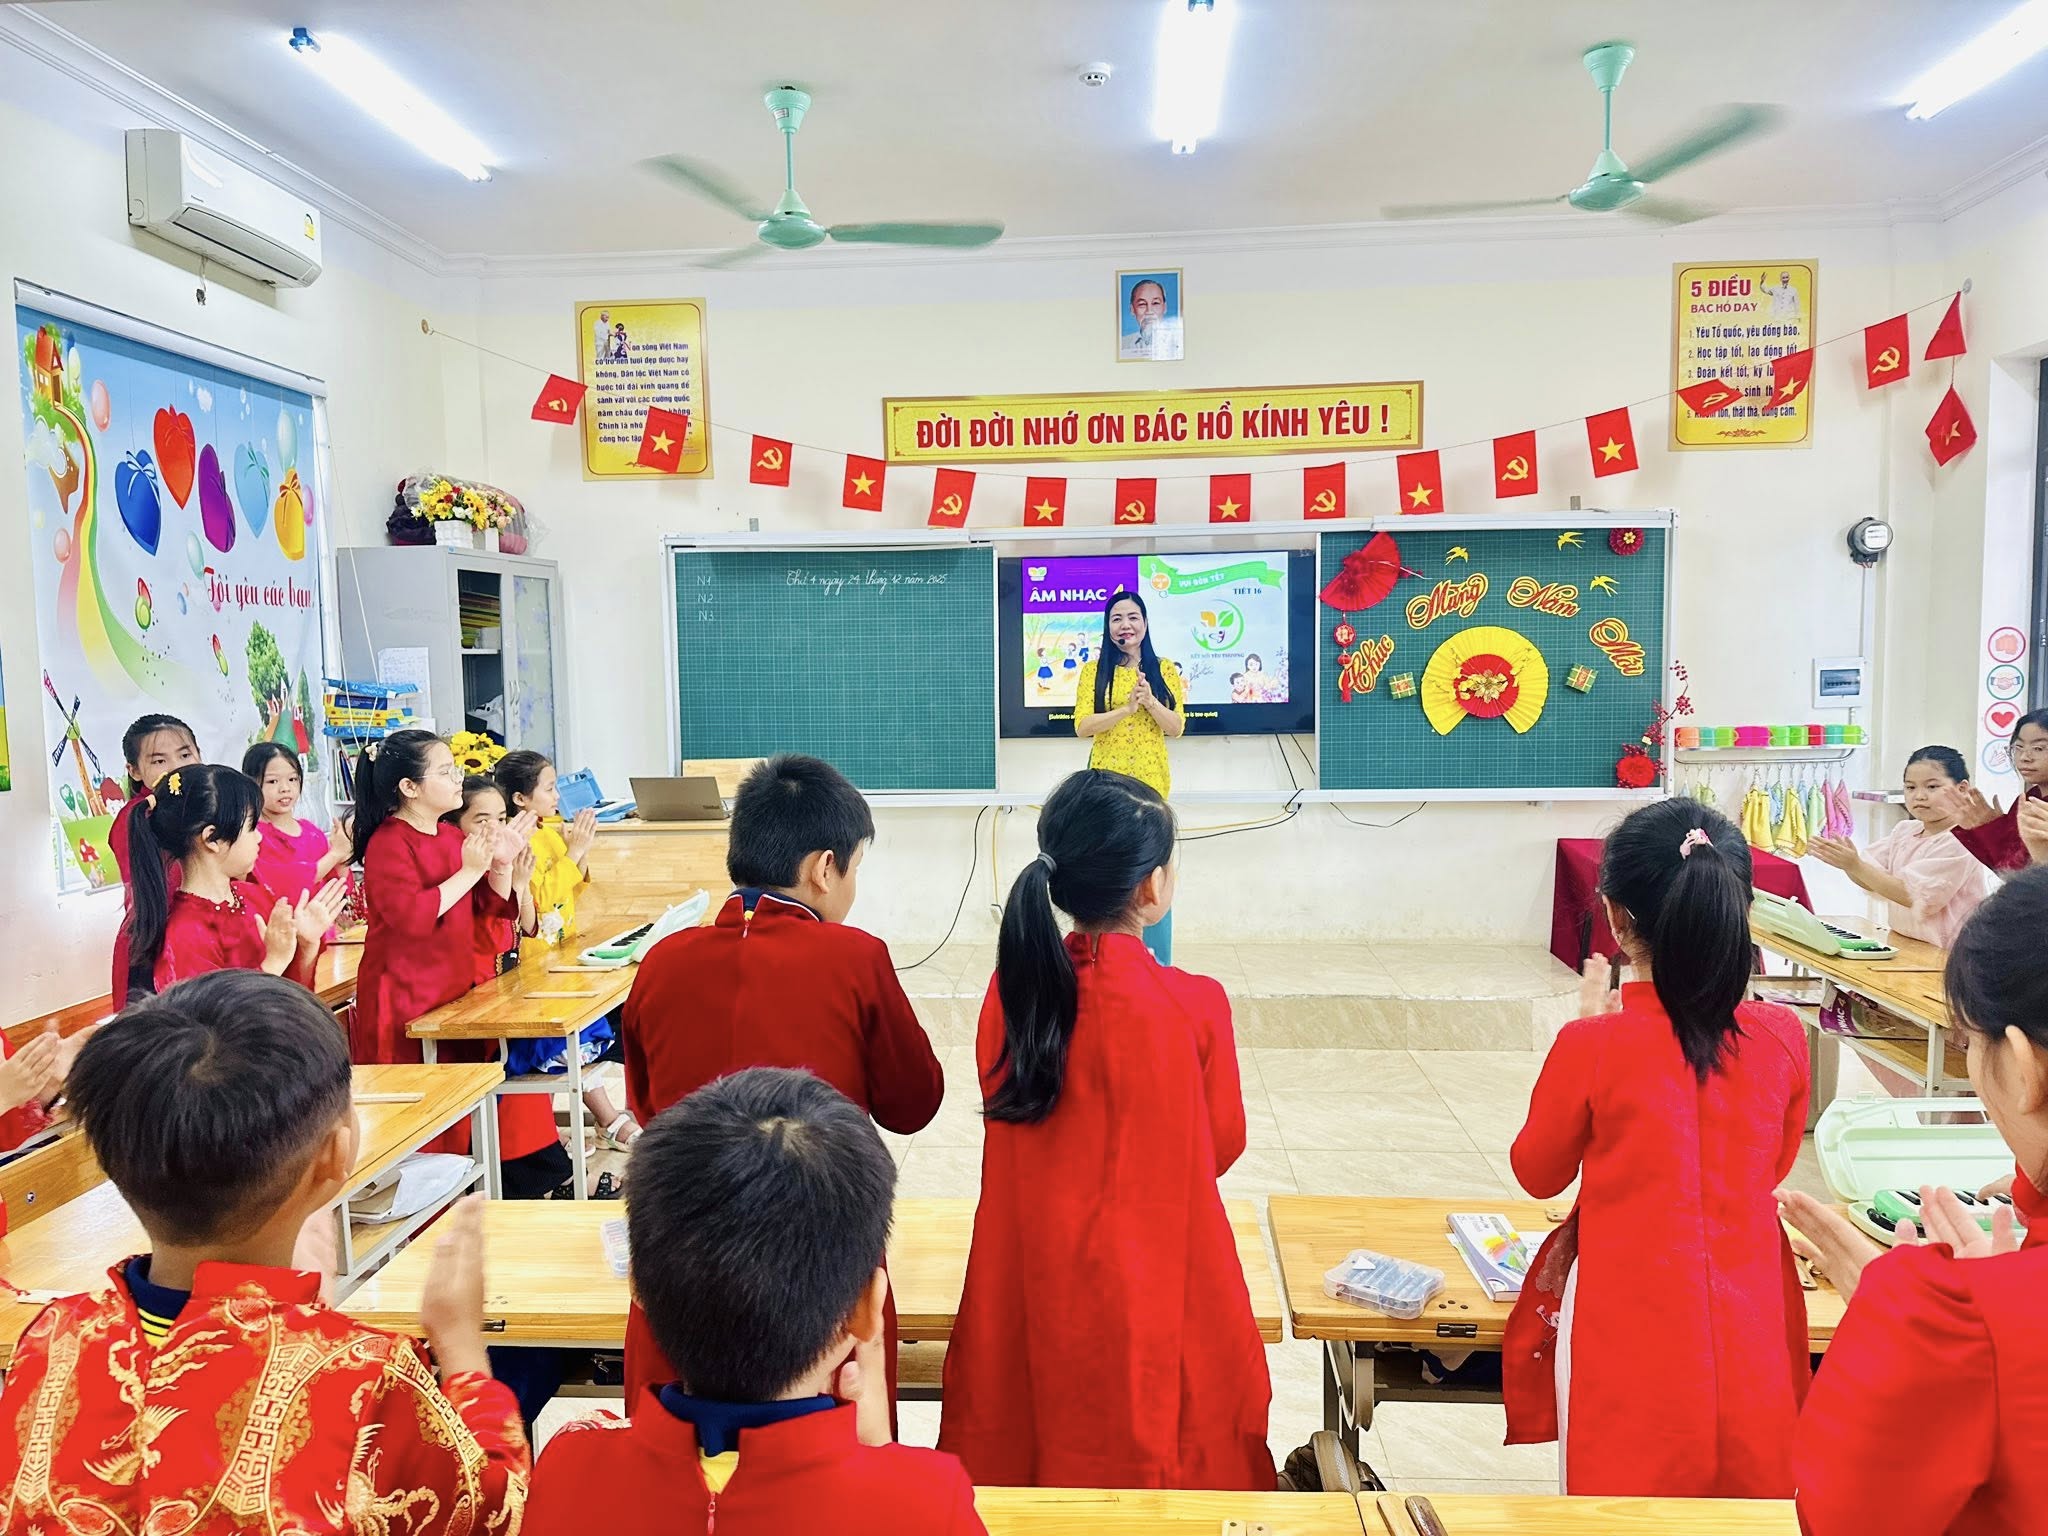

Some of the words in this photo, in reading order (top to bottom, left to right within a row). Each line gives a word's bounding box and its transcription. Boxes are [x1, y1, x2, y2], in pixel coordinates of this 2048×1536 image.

[1691, 281, 1702, 297] 5
[1708, 273, 1751, 297] ĐIỀU
[673, 342, 688, 350] Nam
[917, 412, 960, 449] ĐỜI
[970, 411, 1014, 448] ĐỜI
[1023, 410, 1079, 446] NHỚ
[1087, 413, 1124, 444] ƠN
[1134, 407, 1187, 442] BÁC
[1197, 401, 1232, 440] HỒ
[1242, 403, 1308, 438] KÍNH
[1318, 400, 1370, 436] YÊU
[1381, 404, 1389, 433] !
[204, 566, 231, 602] Tôi
[235, 576, 259, 611] yêu
[264, 580, 285, 606] các
[289, 576, 311, 614] bạn
[819, 570, 845, 595] ngày
[698, 593, 713, 603] N2
[1029, 587, 1056, 602] ÂM
[1060, 588, 1108, 604] NHẠC
